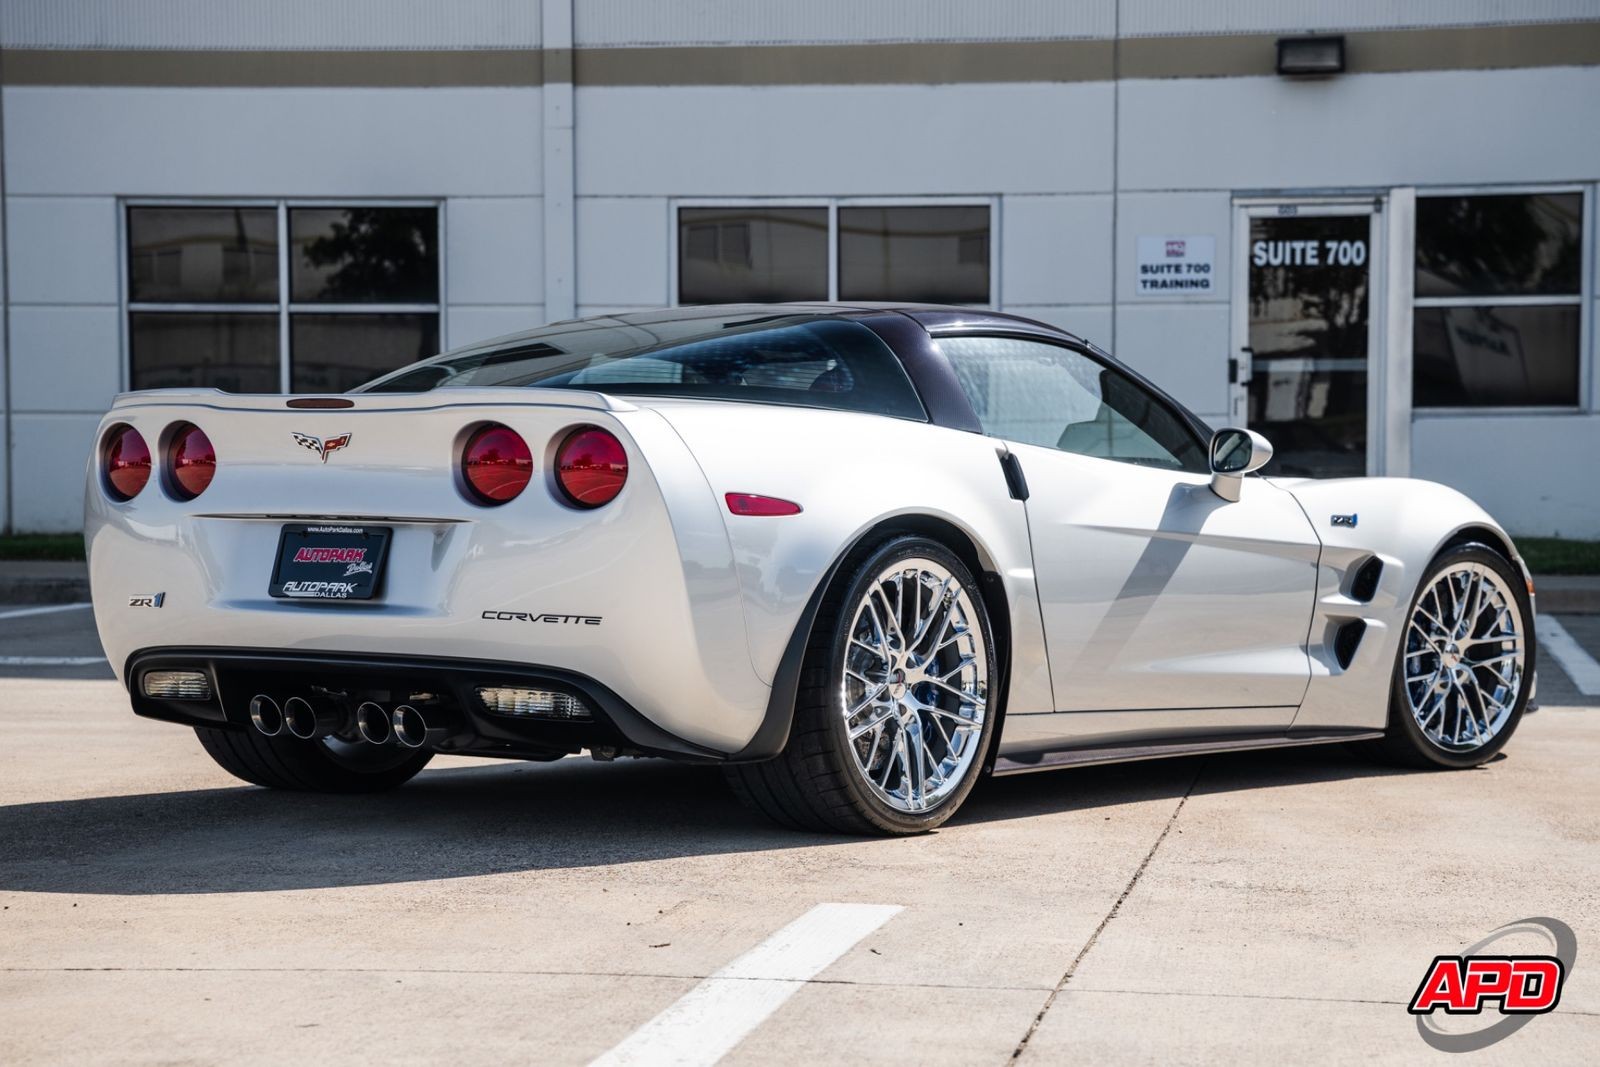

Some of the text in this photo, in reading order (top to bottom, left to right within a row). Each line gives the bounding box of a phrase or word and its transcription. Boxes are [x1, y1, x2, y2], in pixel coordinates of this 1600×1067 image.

[1253, 240, 1366, 267] SUITE 700
[1140, 262, 1211, 274] SUITE 700
[1140, 278, 1210, 290] TRAINING
[293, 547, 367, 563] AUTOPARK
[283, 581, 358, 593] AUTOPARK
[129, 592, 166, 609] ZR1
[314, 591, 348, 599] DALLAS
[481, 610, 603, 626] CORVETTE
